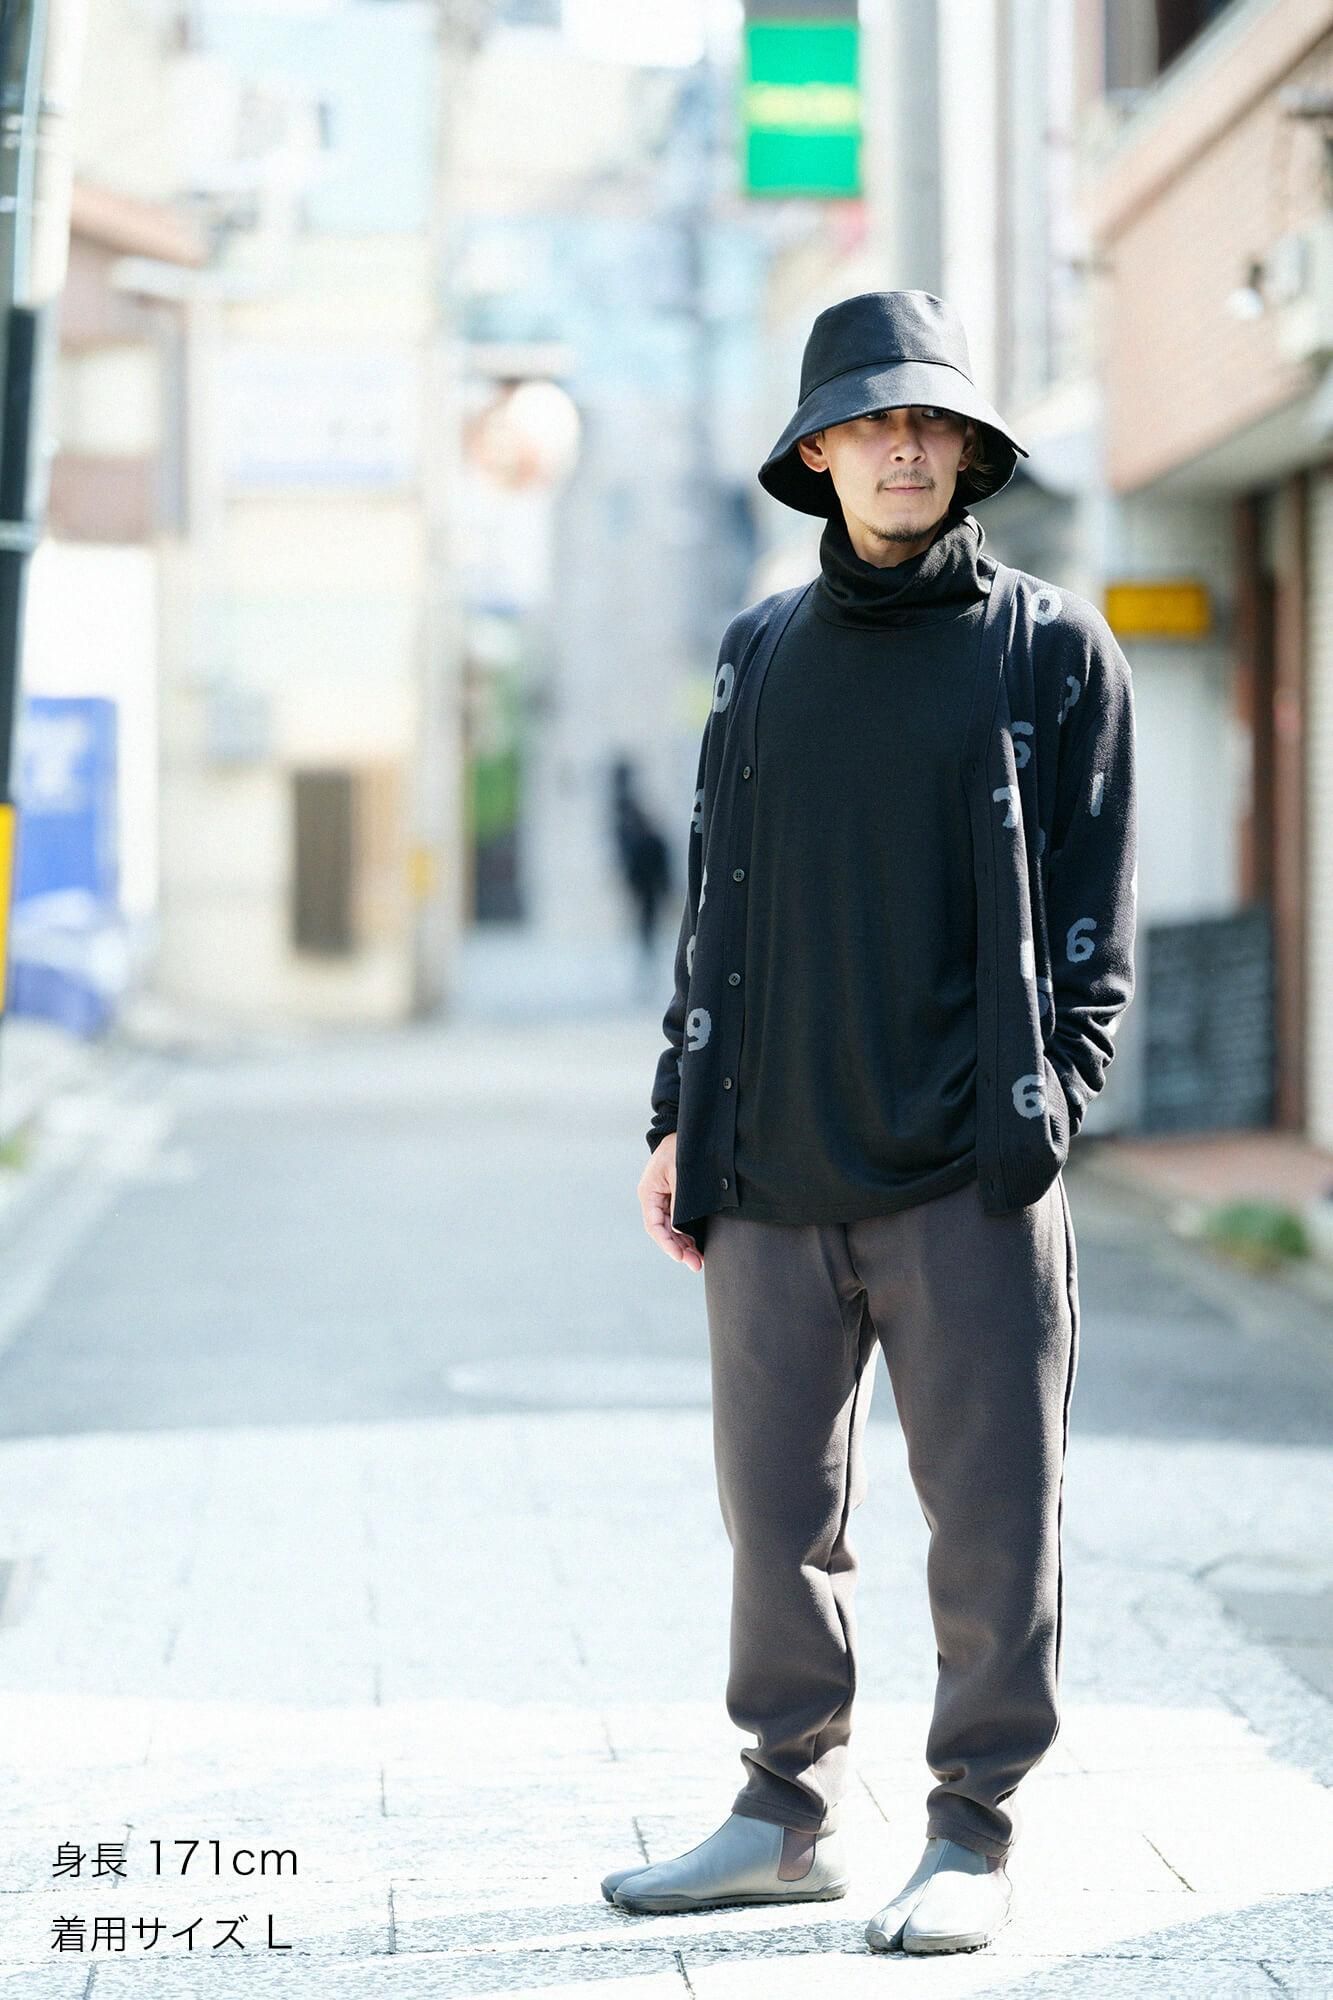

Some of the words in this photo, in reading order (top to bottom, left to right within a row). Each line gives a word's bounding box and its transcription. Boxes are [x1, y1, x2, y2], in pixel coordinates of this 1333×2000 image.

[1028, 588, 1063, 626] 0
[1066, 915, 1098, 964] 6
[686, 1007, 712, 1052] 9
[1011, 1074, 1046, 1121] 6
